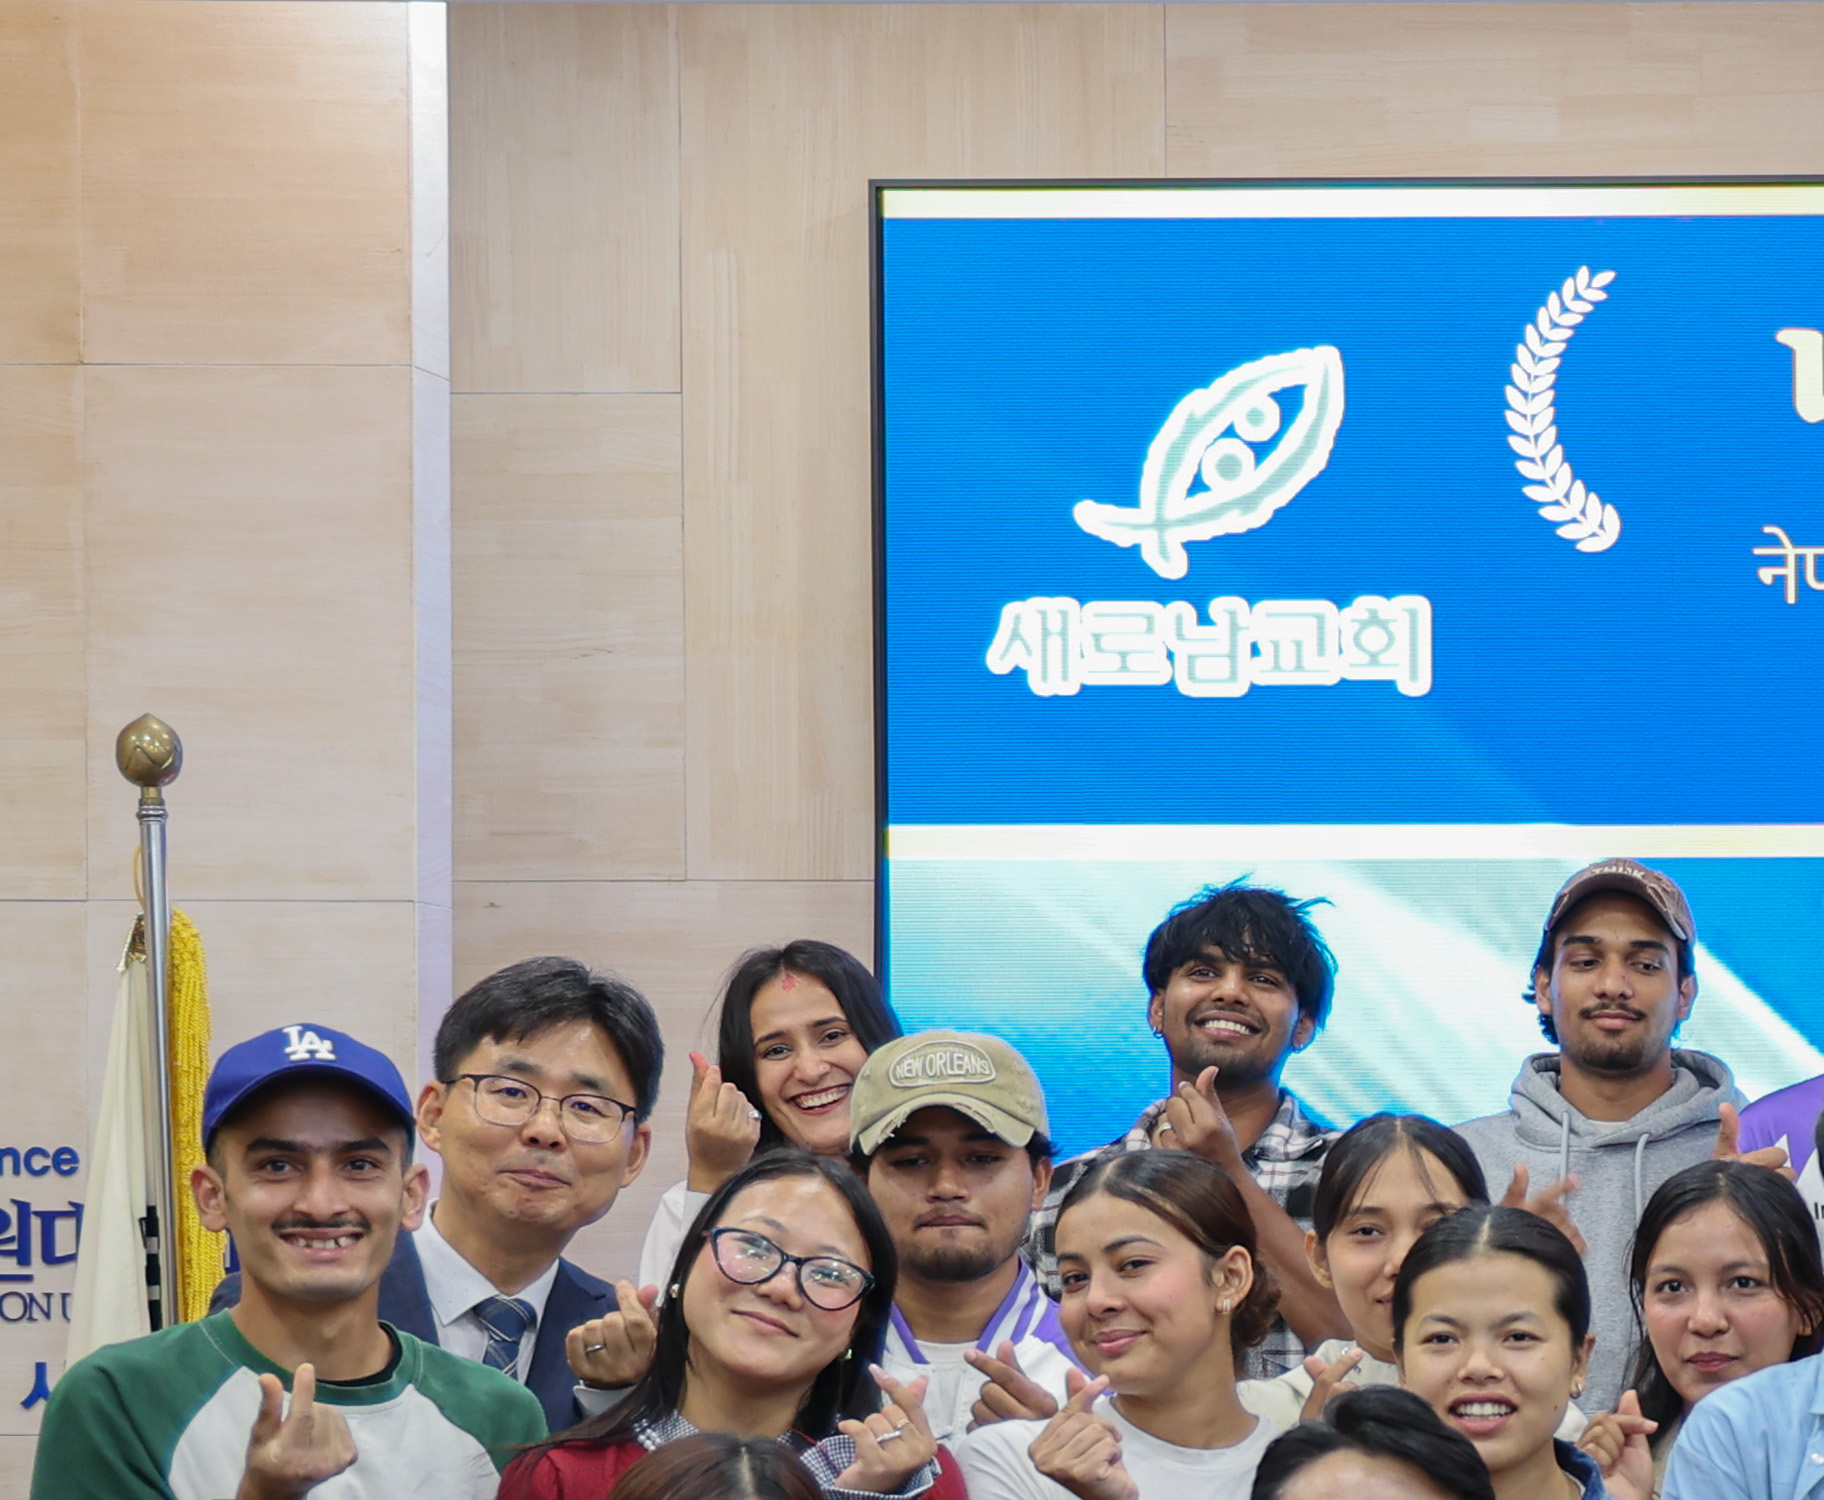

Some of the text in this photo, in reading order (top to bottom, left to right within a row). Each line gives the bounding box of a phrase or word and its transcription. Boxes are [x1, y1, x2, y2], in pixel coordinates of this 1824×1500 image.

[993, 602, 1425, 690] 새로남교회
[282, 1025, 337, 1060] LA
[895, 1051, 990, 1080] NEW ORLEANS
